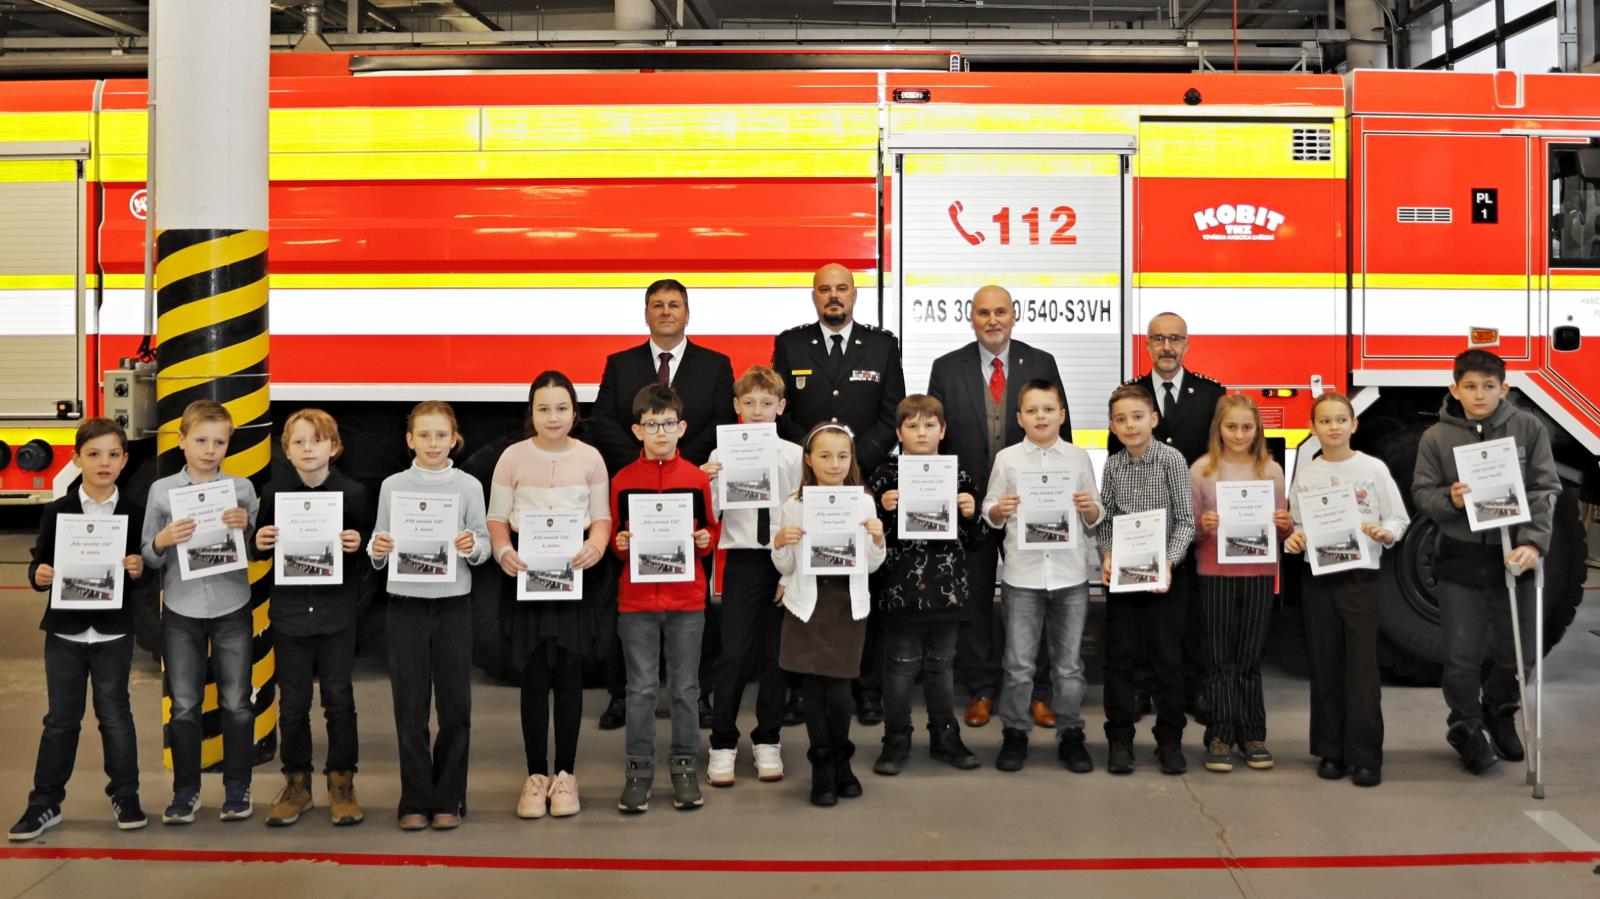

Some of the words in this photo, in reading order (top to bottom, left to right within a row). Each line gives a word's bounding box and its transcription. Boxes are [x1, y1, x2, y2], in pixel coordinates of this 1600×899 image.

[1476, 192, 1493, 204] PL
[1193, 204, 1285, 231] KOBIT
[1480, 208, 1488, 219] 1
[992, 206, 1077, 245] 112
[912, 299, 948, 322] CAS
